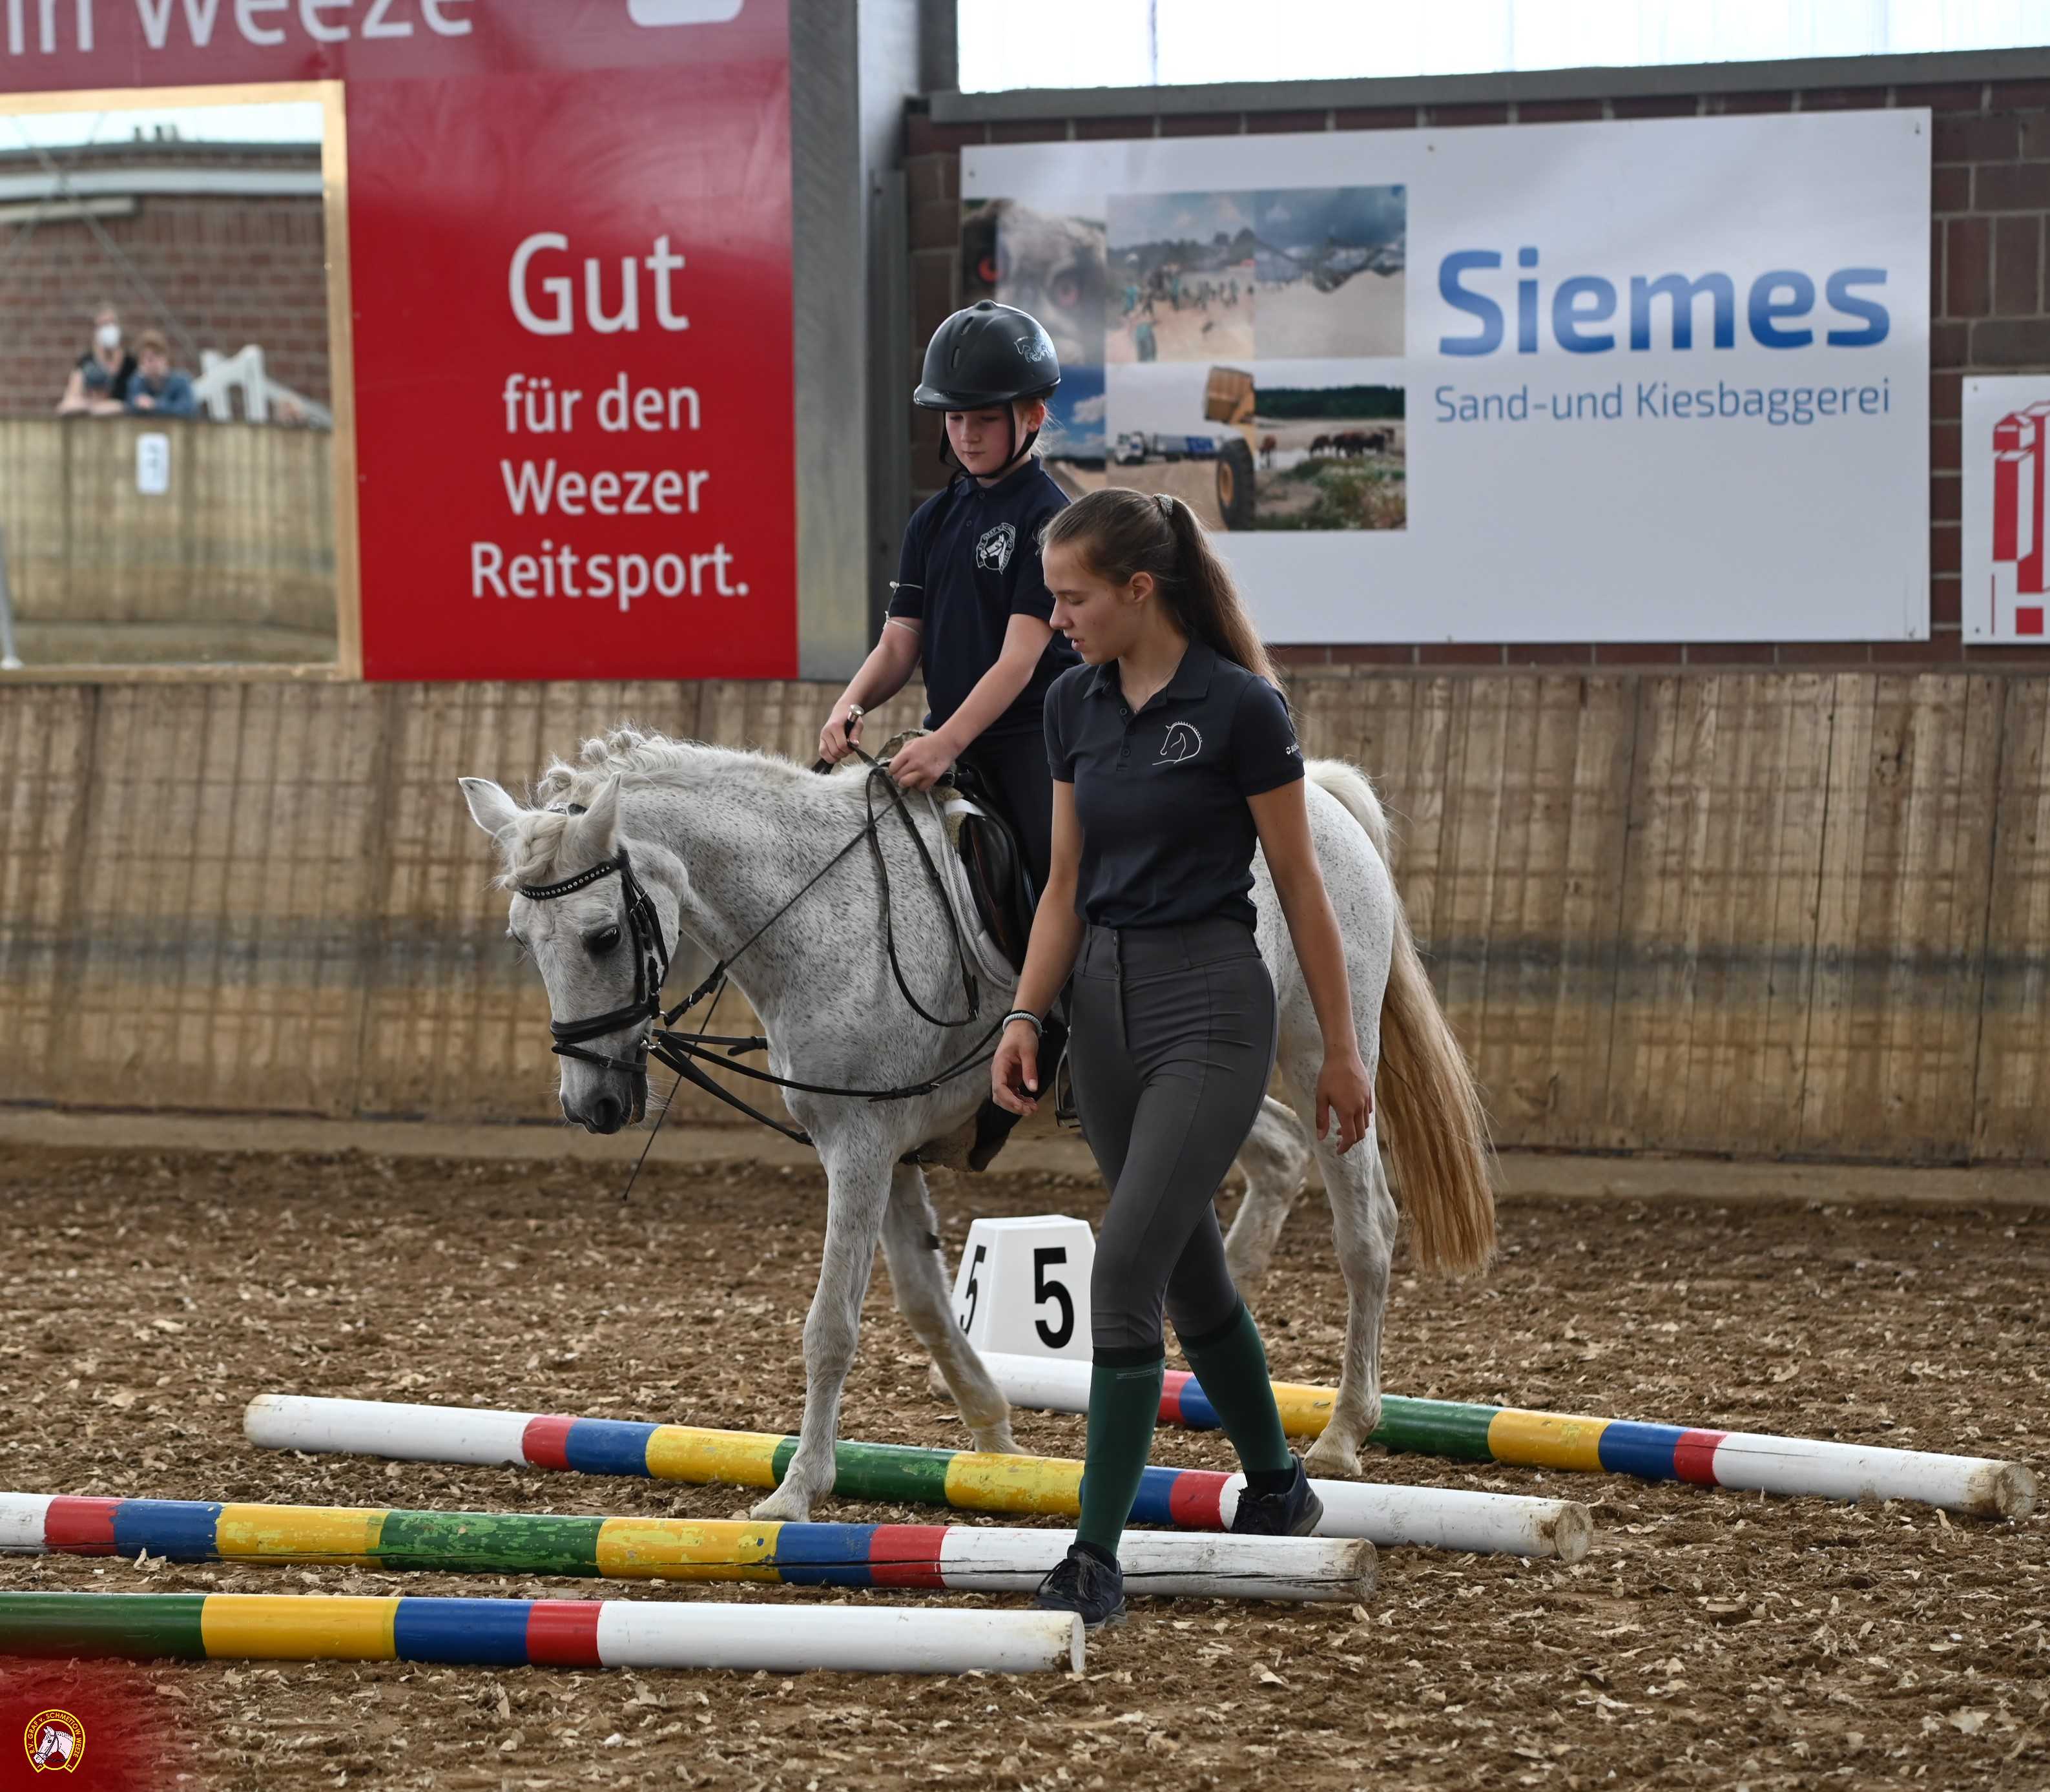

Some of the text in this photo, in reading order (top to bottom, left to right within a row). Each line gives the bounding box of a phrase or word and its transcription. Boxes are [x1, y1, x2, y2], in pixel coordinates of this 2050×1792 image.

[508, 231, 689, 335] Gut
[1438, 245, 1890, 357] Siemes
[502, 371, 699, 433] für den
[1435, 379, 1890, 426] Sand-und Kiesbaggerei
[500, 458, 709, 515] Weezer
[471, 539, 749, 612] Reitsport.
[960, 1244, 986, 1335] 5
[1033, 1246, 1074, 1349] 5
